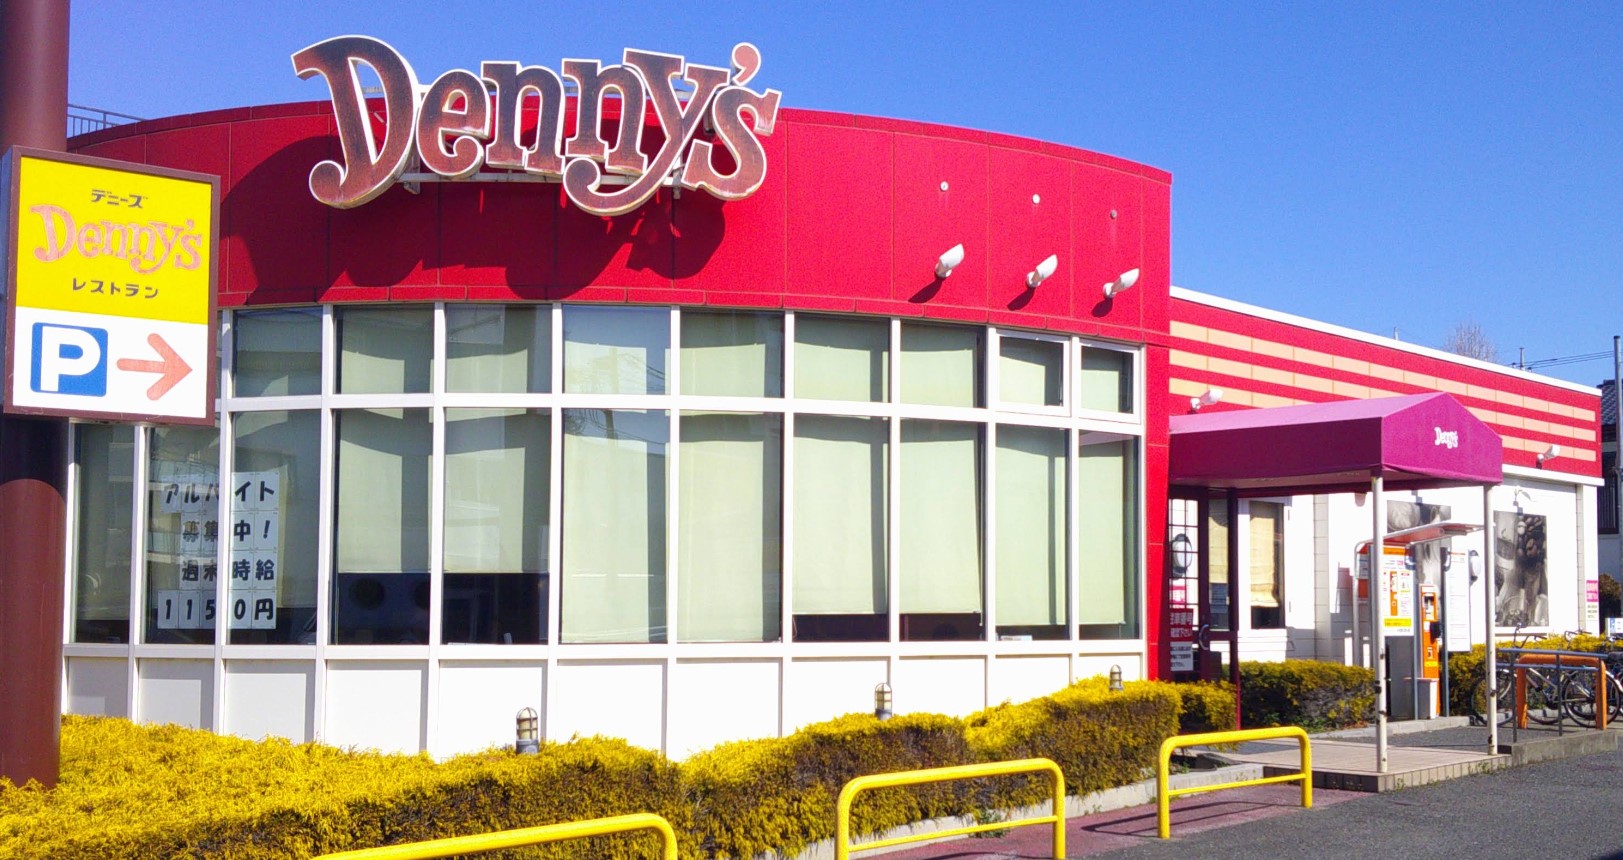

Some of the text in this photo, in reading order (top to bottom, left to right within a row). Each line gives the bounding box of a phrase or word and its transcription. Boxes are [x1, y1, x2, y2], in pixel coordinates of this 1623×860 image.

[291, 34, 782, 216] Denny's
[91, 188, 149, 209] デニーズ
[29, 204, 202, 274] Denny's
[72, 277, 159, 299] レストラン
[164, 597, 274, 621] 1150円
